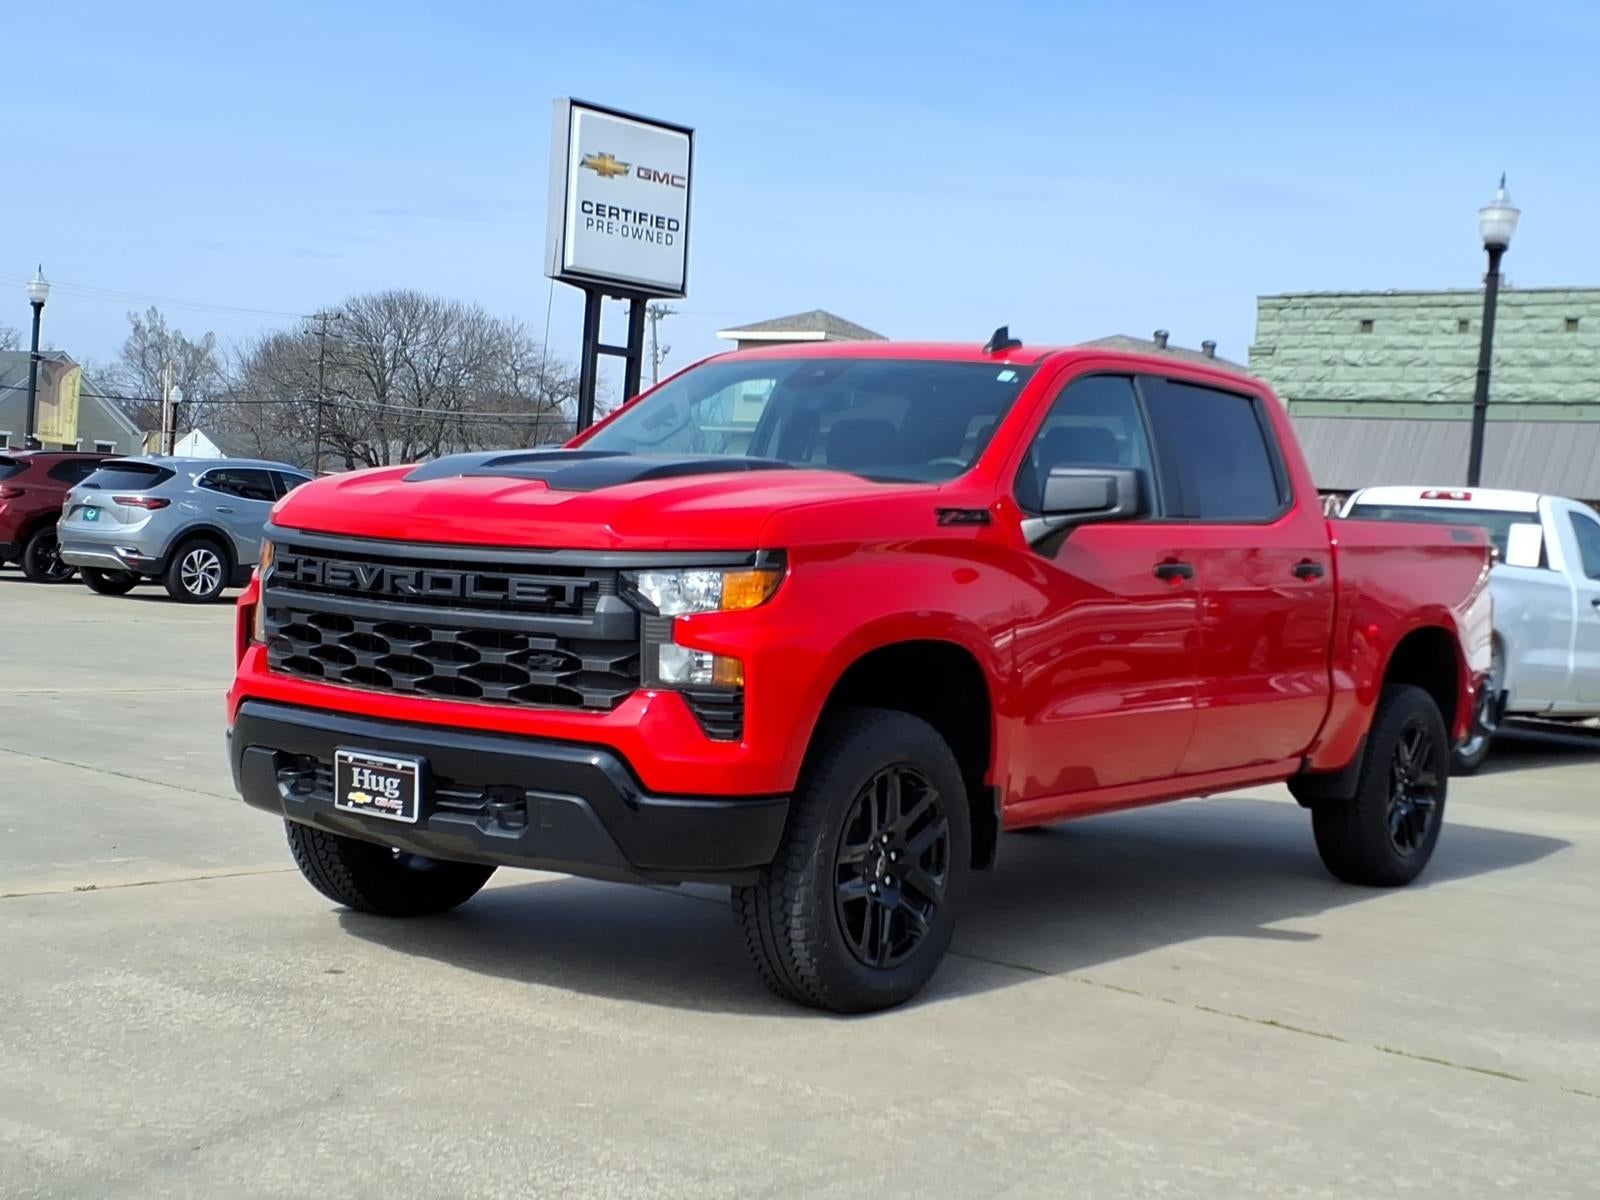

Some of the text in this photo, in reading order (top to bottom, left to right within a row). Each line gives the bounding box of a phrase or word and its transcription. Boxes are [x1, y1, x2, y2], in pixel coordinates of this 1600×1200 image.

[637, 167, 685, 187] GMC
[581, 200, 679, 231] CERTIFIED
[586, 217, 673, 246] PRE-OWNED
[273, 556, 592, 605] CHEVROLET
[351, 767, 400, 798] Hug
